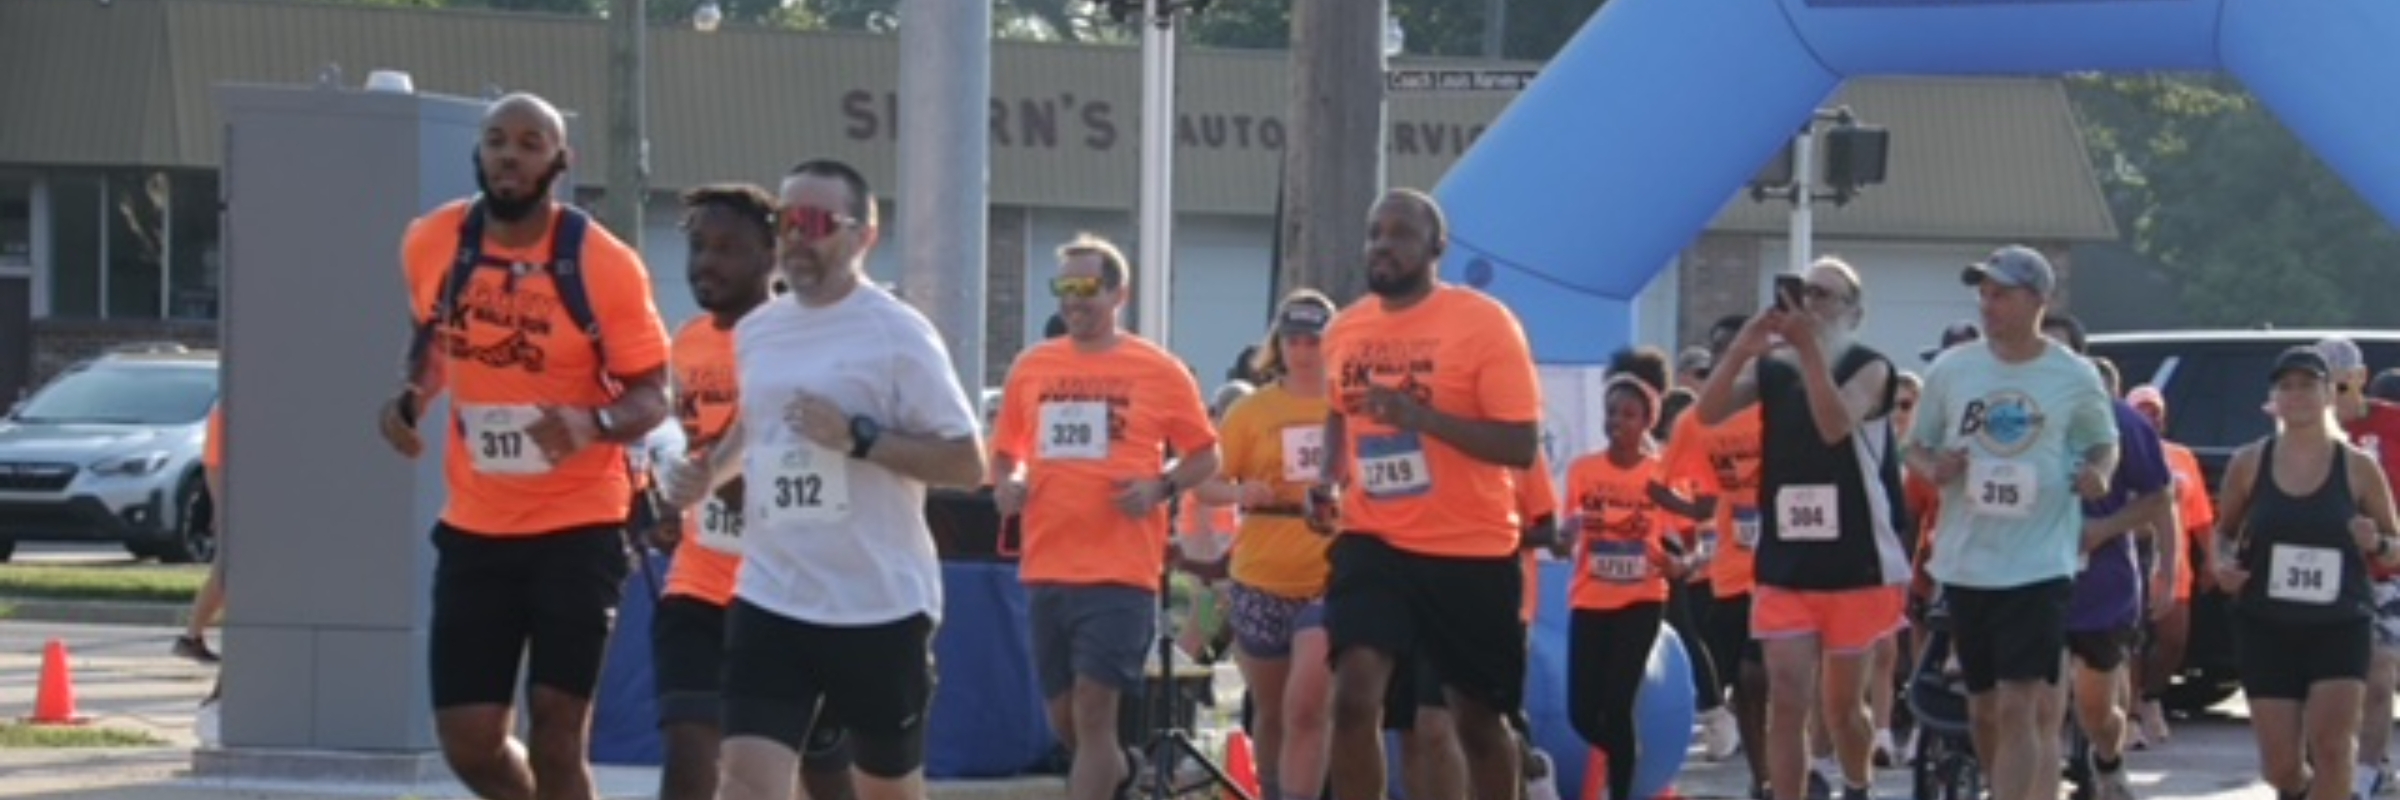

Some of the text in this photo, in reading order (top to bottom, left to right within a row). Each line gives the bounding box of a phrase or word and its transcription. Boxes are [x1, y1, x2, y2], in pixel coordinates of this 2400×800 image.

[1178, 115, 1287, 151] AUTO
[480, 430, 522, 460] 317
[1052, 422, 1092, 446] 320
[774, 472, 822, 509] 312
[1982, 480, 2019, 507] 315
[1789, 505, 1825, 528] 304
[2286, 565, 2323, 591] 314
